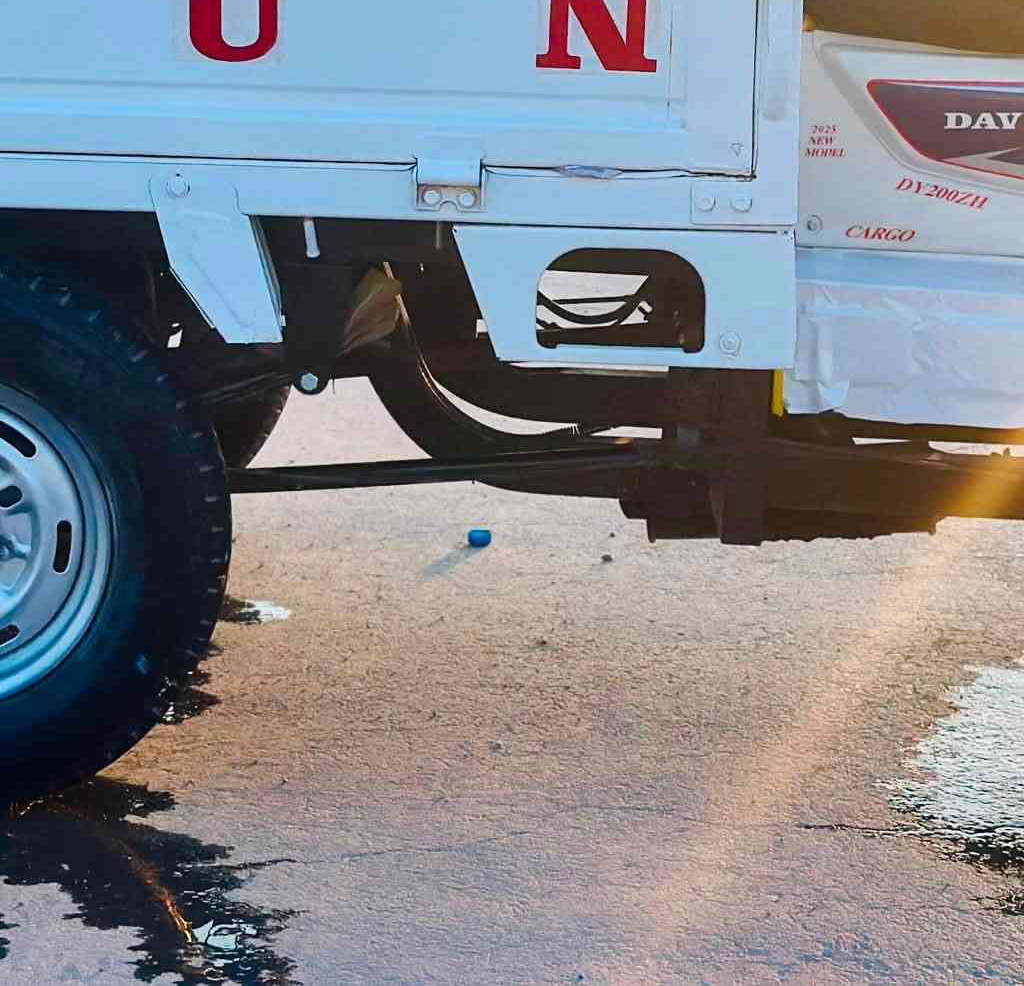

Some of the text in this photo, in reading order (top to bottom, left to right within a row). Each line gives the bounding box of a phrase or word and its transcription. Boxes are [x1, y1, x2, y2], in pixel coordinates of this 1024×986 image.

[808, 136, 836, 145] NEW
[804, 148, 846, 158] MODEL
[895, 178, 989, 209] DY200ZH
[845, 225, 916, 242] CARGO
